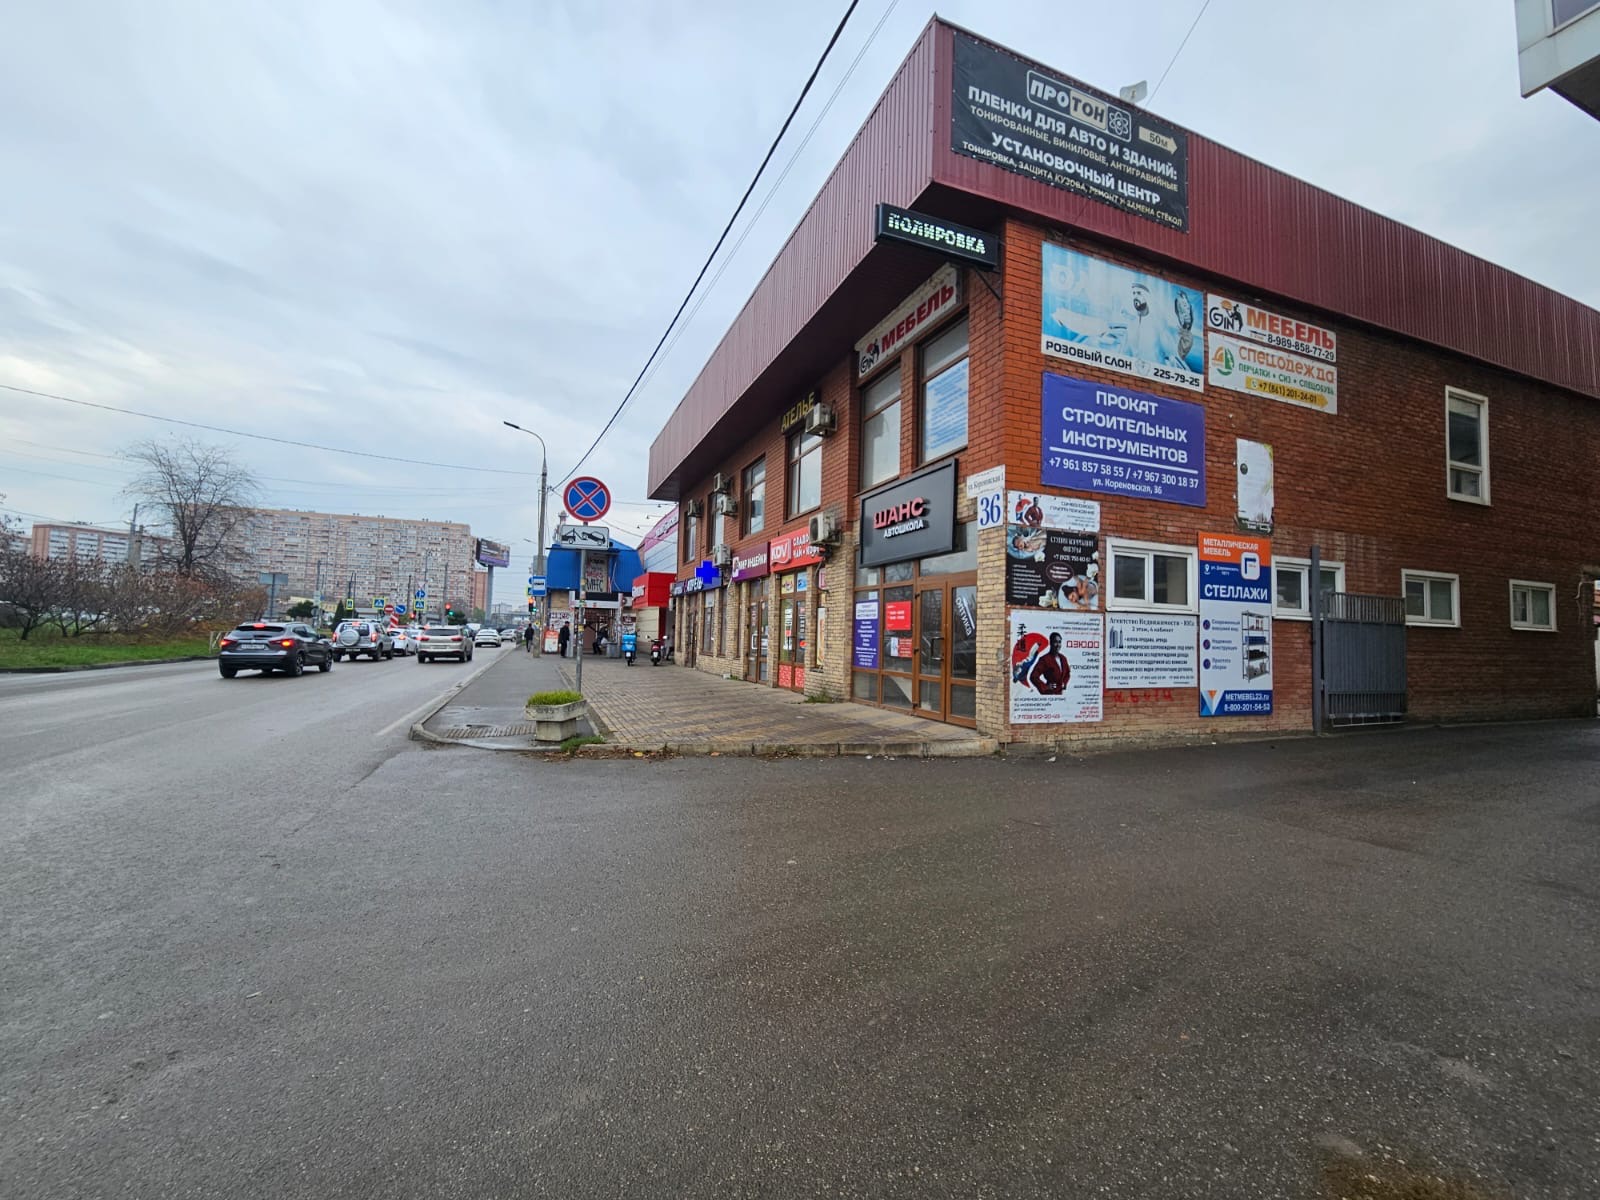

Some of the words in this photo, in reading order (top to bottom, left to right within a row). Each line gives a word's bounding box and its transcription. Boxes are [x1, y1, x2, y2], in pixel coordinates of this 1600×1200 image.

[1030, 80, 1106, 123] ПРОТОН
[968, 86, 1032, 121] ПЛЕНКИ
[1035, 114, 1066, 135] ДЛЯ
[1069, 126, 1107, 151] АВТО
[1109, 141, 1120, 156] И
[1122, 147, 1178, 180] ЗДАНИЙ:
[970, 105, 1051, 145] ТОНИРОВАННЫЕ,
[1053, 136, 1109, 166] ВИНИЛОВЫЕ,
[1110, 160, 1178, 193] АНТИГРАВИЙНЫЕ
[962, 141, 1017, 167] ТОНИРОВКА,
[1018, 159, 1053, 180] ЗАЩИТА
[1055, 172, 1087, 192] КУЗОВА,
[1126, 199, 1155, 216] ЗАМЕНА
[991, 132, 1115, 190] УСТАНОВОЧНЫЙ
[1118, 180, 1161, 205] ЦЕНТР
[888, 212, 986, 254] ПОЛИРОВКА
[880, 284, 955, 353] МЕБЕЛЬ
[1246, 307, 1334, 350] МЕБЕЛЬ
[1046, 339, 1103, 365] РОЗОВЫЙ
[1104, 354, 1132, 371] СЛОН
[1153, 367, 1200, 388] 225-79-25
[1267, 334, 1334, 361] 8-989-858-77-29
[1239, 362, 1271, 379] ПЕРЧАТКИ
[1278, 373, 1292, 384] СИЗ
[1299, 378, 1334, 395] СПЕЦОБУВЬ
[1259, 381, 1268, 390] +7
[1286, 387, 1317, 402] 201-24-01
[781, 391, 815, 433] АТЕЛЬЕ
[1095, 389, 1159, 417] ПРОКАТ
[1061, 406, 1188, 443] СТРОИТЕЛЬНЫХ
[1062, 429, 1188, 464] ИНСТРУМЕНТОВ
[1049, 457, 1061, 469] +7
[1063, 458, 1080, 472] 961
[1082, 460, 1099, 474] 857
[1101, 463, 1112, 476] 58
[1113, 465, 1124, 478] 55
[1132, 468, 1143, 480] +7
[1144, 469, 1161, 483] 967
[1162, 472, 1177, 486] 300
[1178, 474, 1187, 487] 18
[1188, 476, 1199, 489] 37
[1092, 477, 1104, 488] ул.
[1105, 478, 1148, 495] Кореновская,
[1150, 484, 1163, 496] 36
[873, 497, 925, 530] ШАНС
[980, 493, 1001, 526] 36
[883, 518, 924, 539] АВТОШКОЛА
[1203, 537, 1259, 551] МЕТАЛЛИЧЕСКАЯ
[1203, 547, 1232, 557] МЕБЕЛЬ
[1204, 583, 1268, 601] СТЕЛЛАЖИ
[1066, 640, 1100, 649] ДЗЮДО
